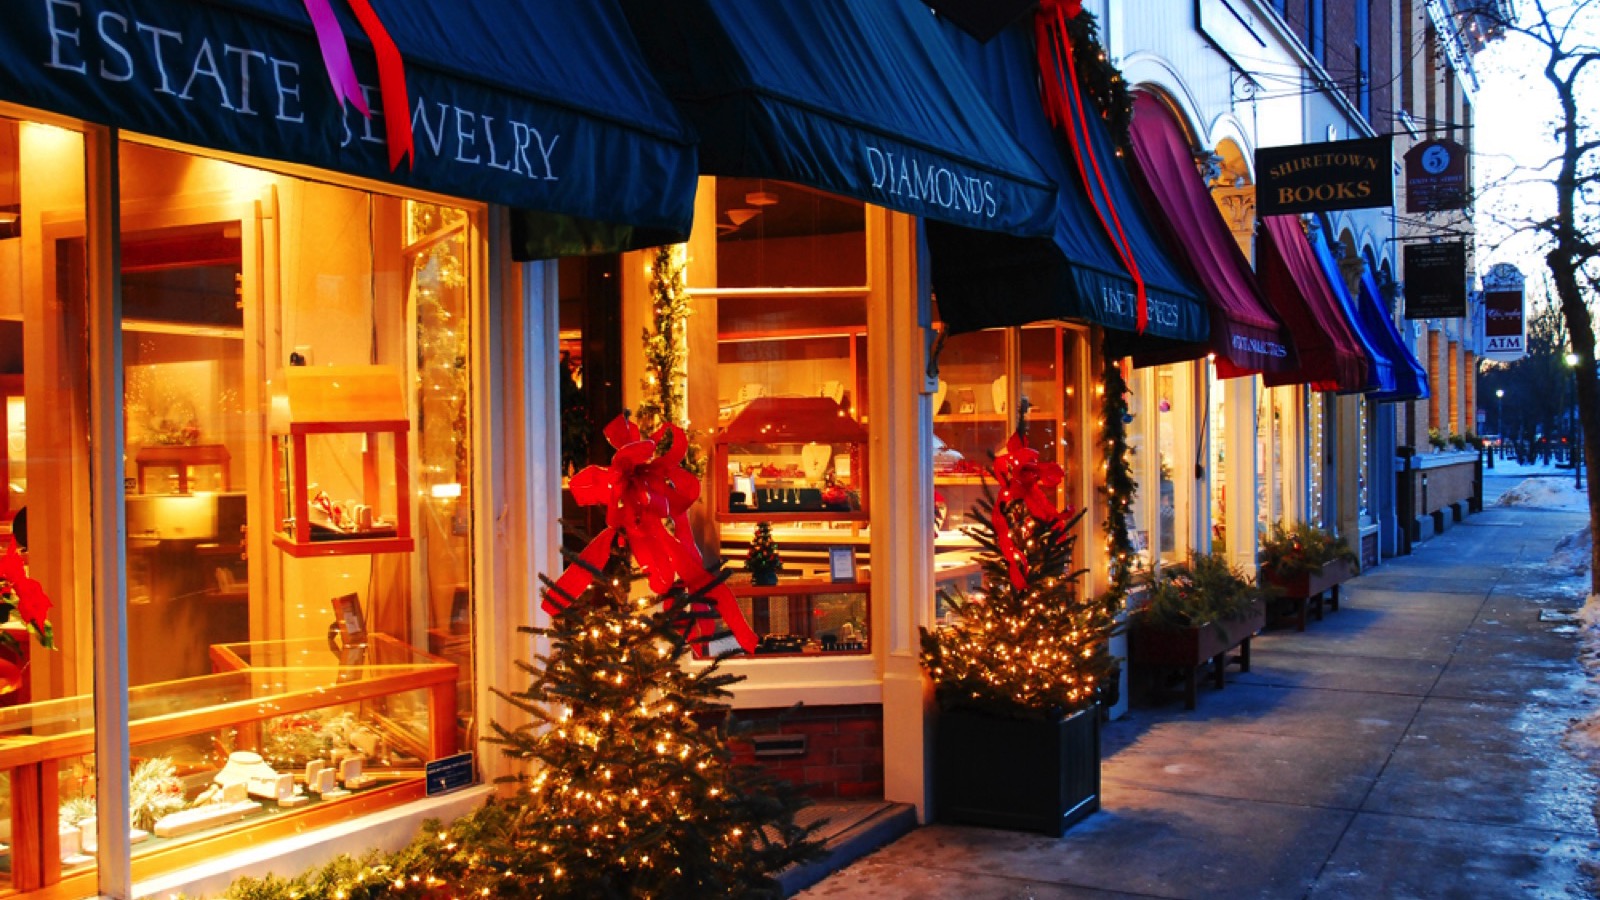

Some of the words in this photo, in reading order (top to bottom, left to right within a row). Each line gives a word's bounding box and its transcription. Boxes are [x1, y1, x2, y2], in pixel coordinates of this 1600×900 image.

[45, 0, 304, 122] ESTATE
[340, 83, 560, 180] JEWELRY
[1269, 152, 1380, 179] SHIRETOWN
[1429, 150, 1443, 168] 5
[866, 146, 996, 218] DIAMONDS
[1278, 180, 1371, 204] BOOKS
[1488, 336, 1520, 348] ATM
